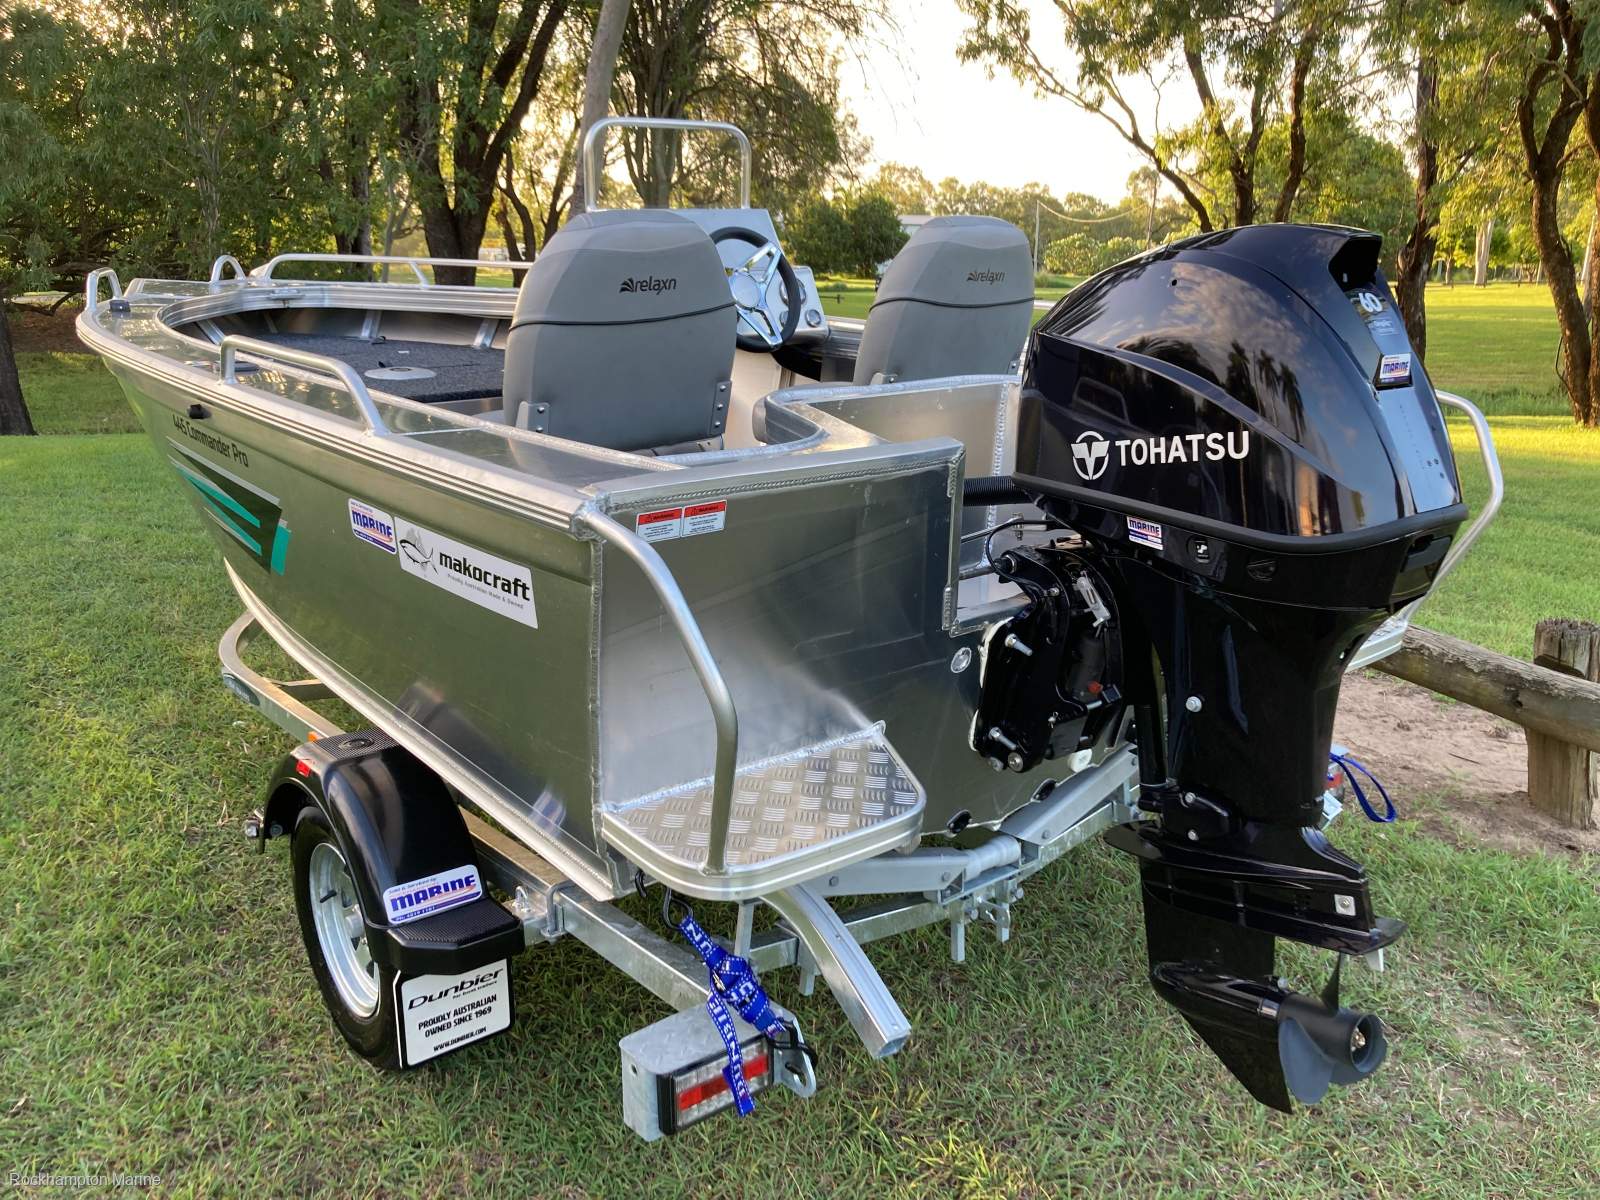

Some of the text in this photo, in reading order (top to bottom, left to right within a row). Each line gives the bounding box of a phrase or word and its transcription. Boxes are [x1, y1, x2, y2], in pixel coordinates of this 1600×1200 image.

[635, 275, 677, 296] relaxn
[977, 268, 1006, 285] relaxn
[1358, 292, 1383, 313] 60
[1382, 361, 1409, 375] MARINE
[172, 413, 249, 468] 445 Commander Pro
[1115, 430, 1250, 467] TOHATSU
[351, 510, 393, 538] MARINE
[1129, 519, 1160, 535] MARINE
[439, 552, 531, 602] makocraft
[390, 874, 476, 912] MARINE
[418, 994, 497, 1030] PROUDLY AUSTRALIAN
[424, 1006, 492, 1038] OWNED SINCE 1969
